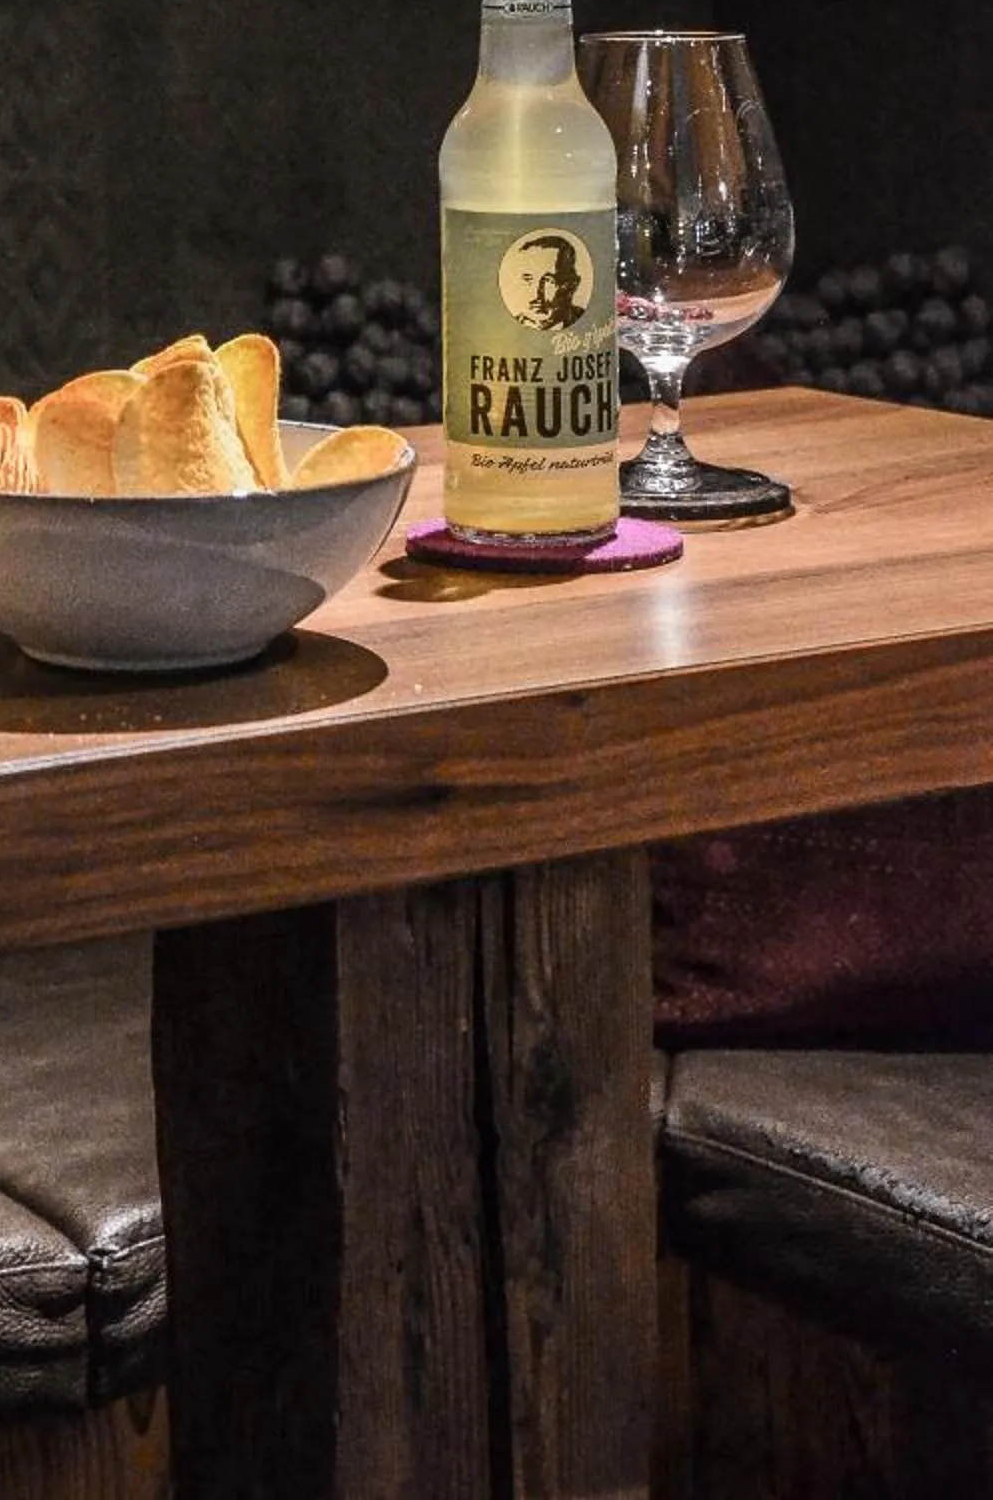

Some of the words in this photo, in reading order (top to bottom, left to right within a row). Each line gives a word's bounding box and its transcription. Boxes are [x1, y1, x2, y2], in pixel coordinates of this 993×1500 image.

[470, 355, 543, 382] FRANZ
[557, 351, 612, 382] JOSEF
[470, 380, 612, 438] RAUCH
